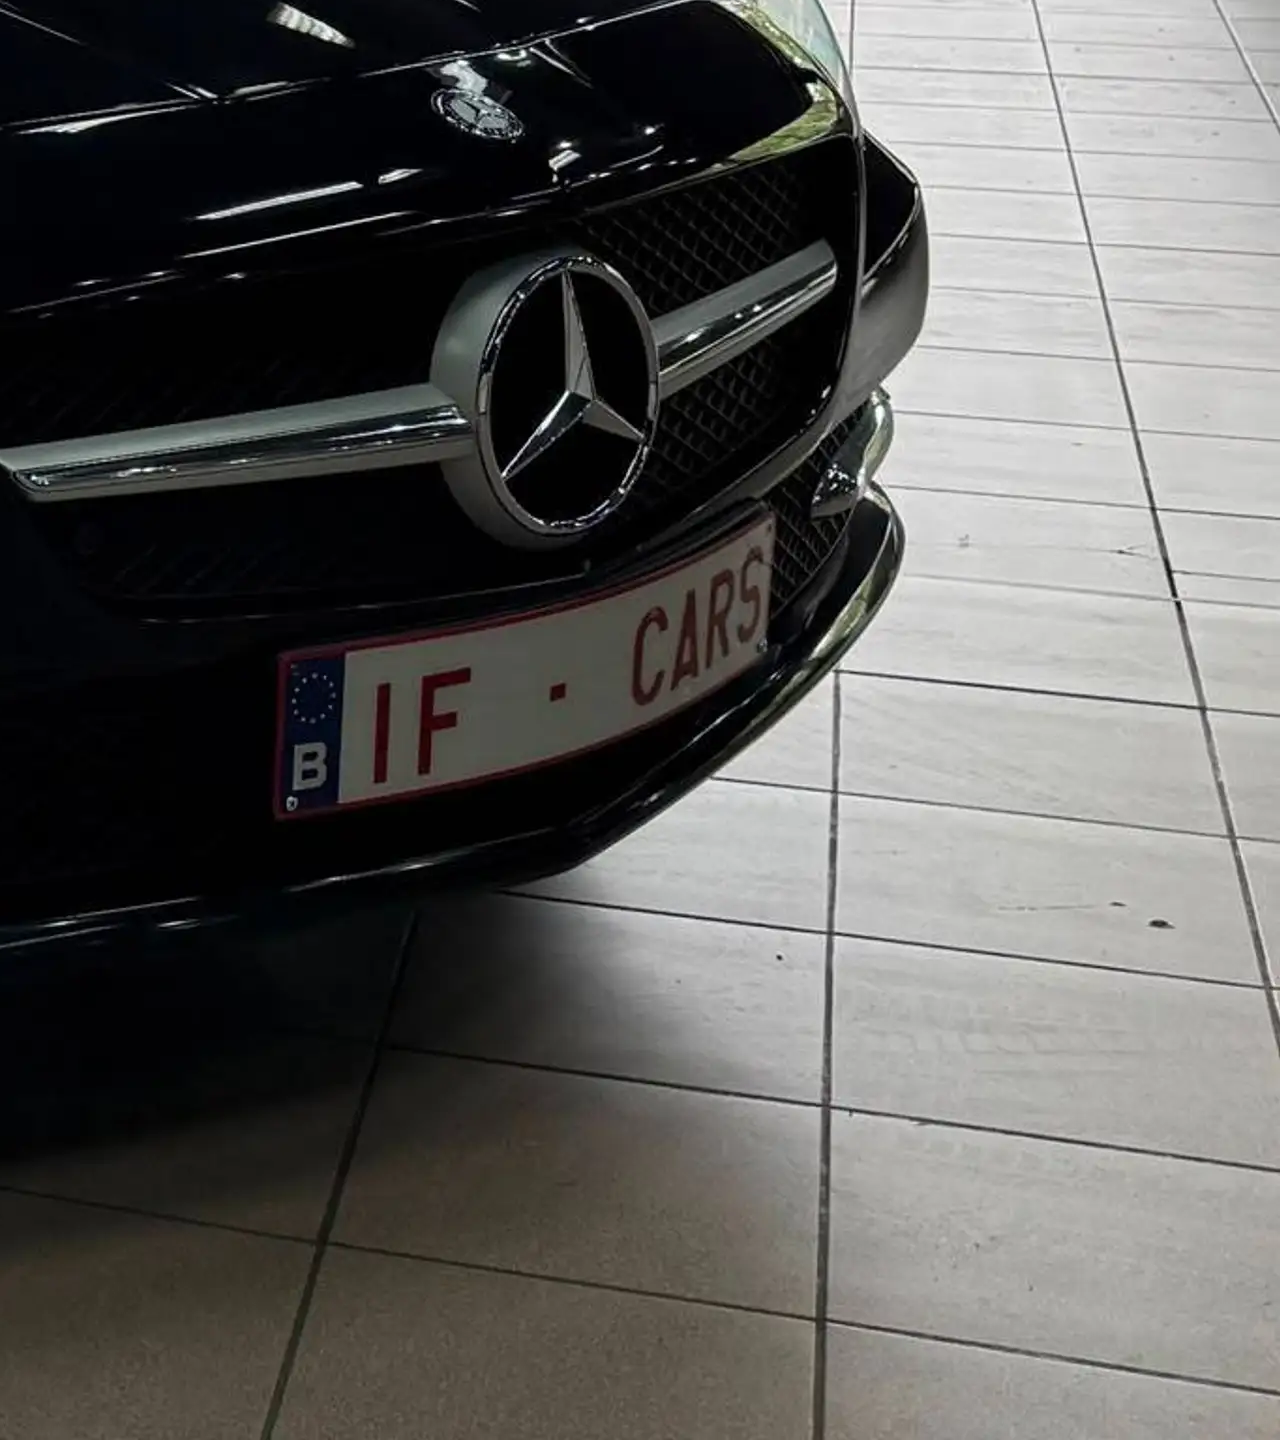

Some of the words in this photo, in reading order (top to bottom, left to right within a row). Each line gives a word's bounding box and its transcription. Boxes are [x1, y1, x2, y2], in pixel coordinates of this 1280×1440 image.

[373, 667, 471, 784] IF
[631, 546, 764, 706] CARS
[292, 741, 328, 791] B
